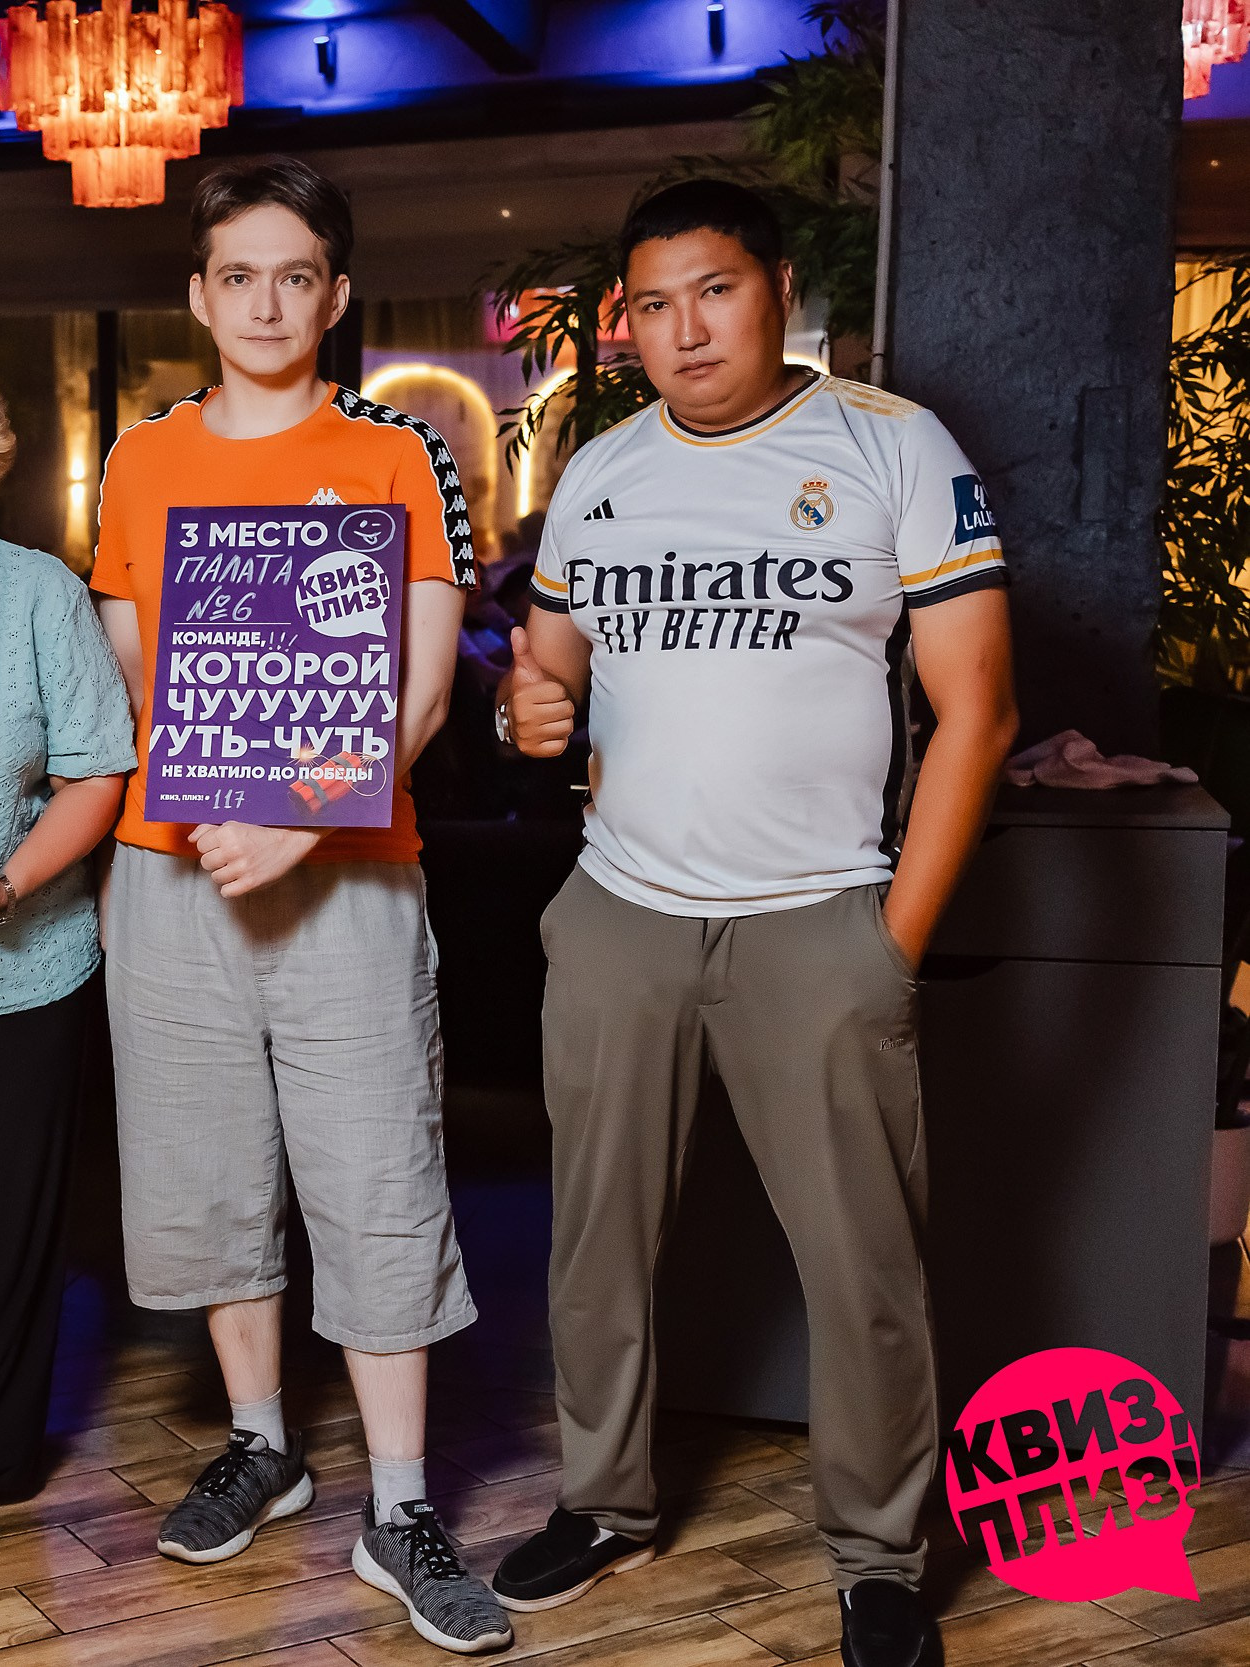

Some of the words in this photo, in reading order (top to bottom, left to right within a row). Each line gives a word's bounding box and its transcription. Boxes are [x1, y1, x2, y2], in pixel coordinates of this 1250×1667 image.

[179, 522, 199, 548] 3
[208, 520, 329, 547] МЕСТО
[174, 552, 293, 586] ПАЛАТА
[565, 549, 854, 611] Emirates
[300, 584, 390, 625] ПЛИЗ!
[171, 631, 267, 648] КОМАНДЕ,
[597, 610, 650, 654] FLY
[661, 608, 801, 651] BETTER
[168, 644, 391, 685] КОТОРОЙ
[161, 765, 183, 778] НЕ
[186, 765, 265, 779] ХВАТИЛО
[268, 766, 295, 781] ДО
[298, 766, 373, 783] ПОБЕДЫ
[212, 789, 246, 809] 117
